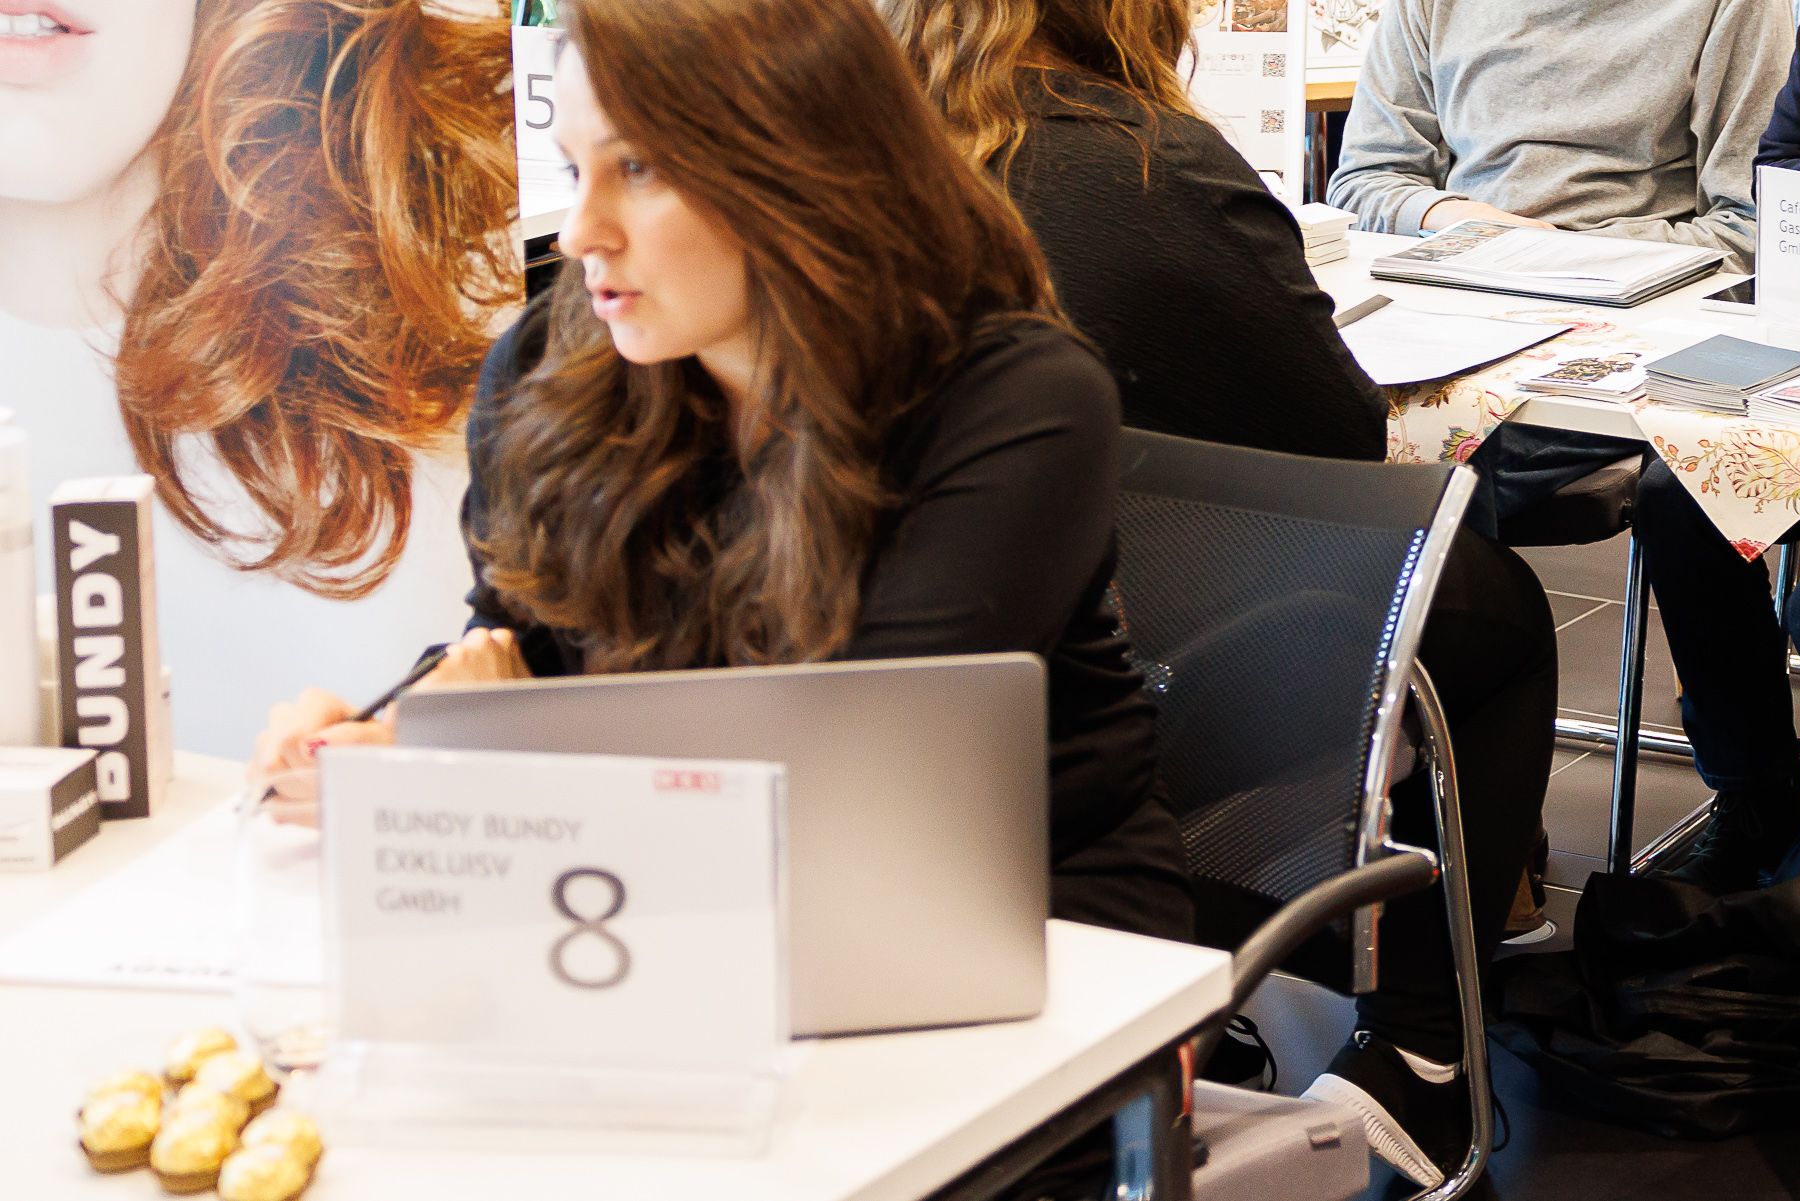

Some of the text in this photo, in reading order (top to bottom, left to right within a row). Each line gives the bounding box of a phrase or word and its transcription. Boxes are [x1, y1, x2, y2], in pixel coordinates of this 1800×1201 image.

[525, 74, 554, 130] 5
[374, 808, 583, 842] BUNDY BUNDY
[549, 865, 632, 991] 8
